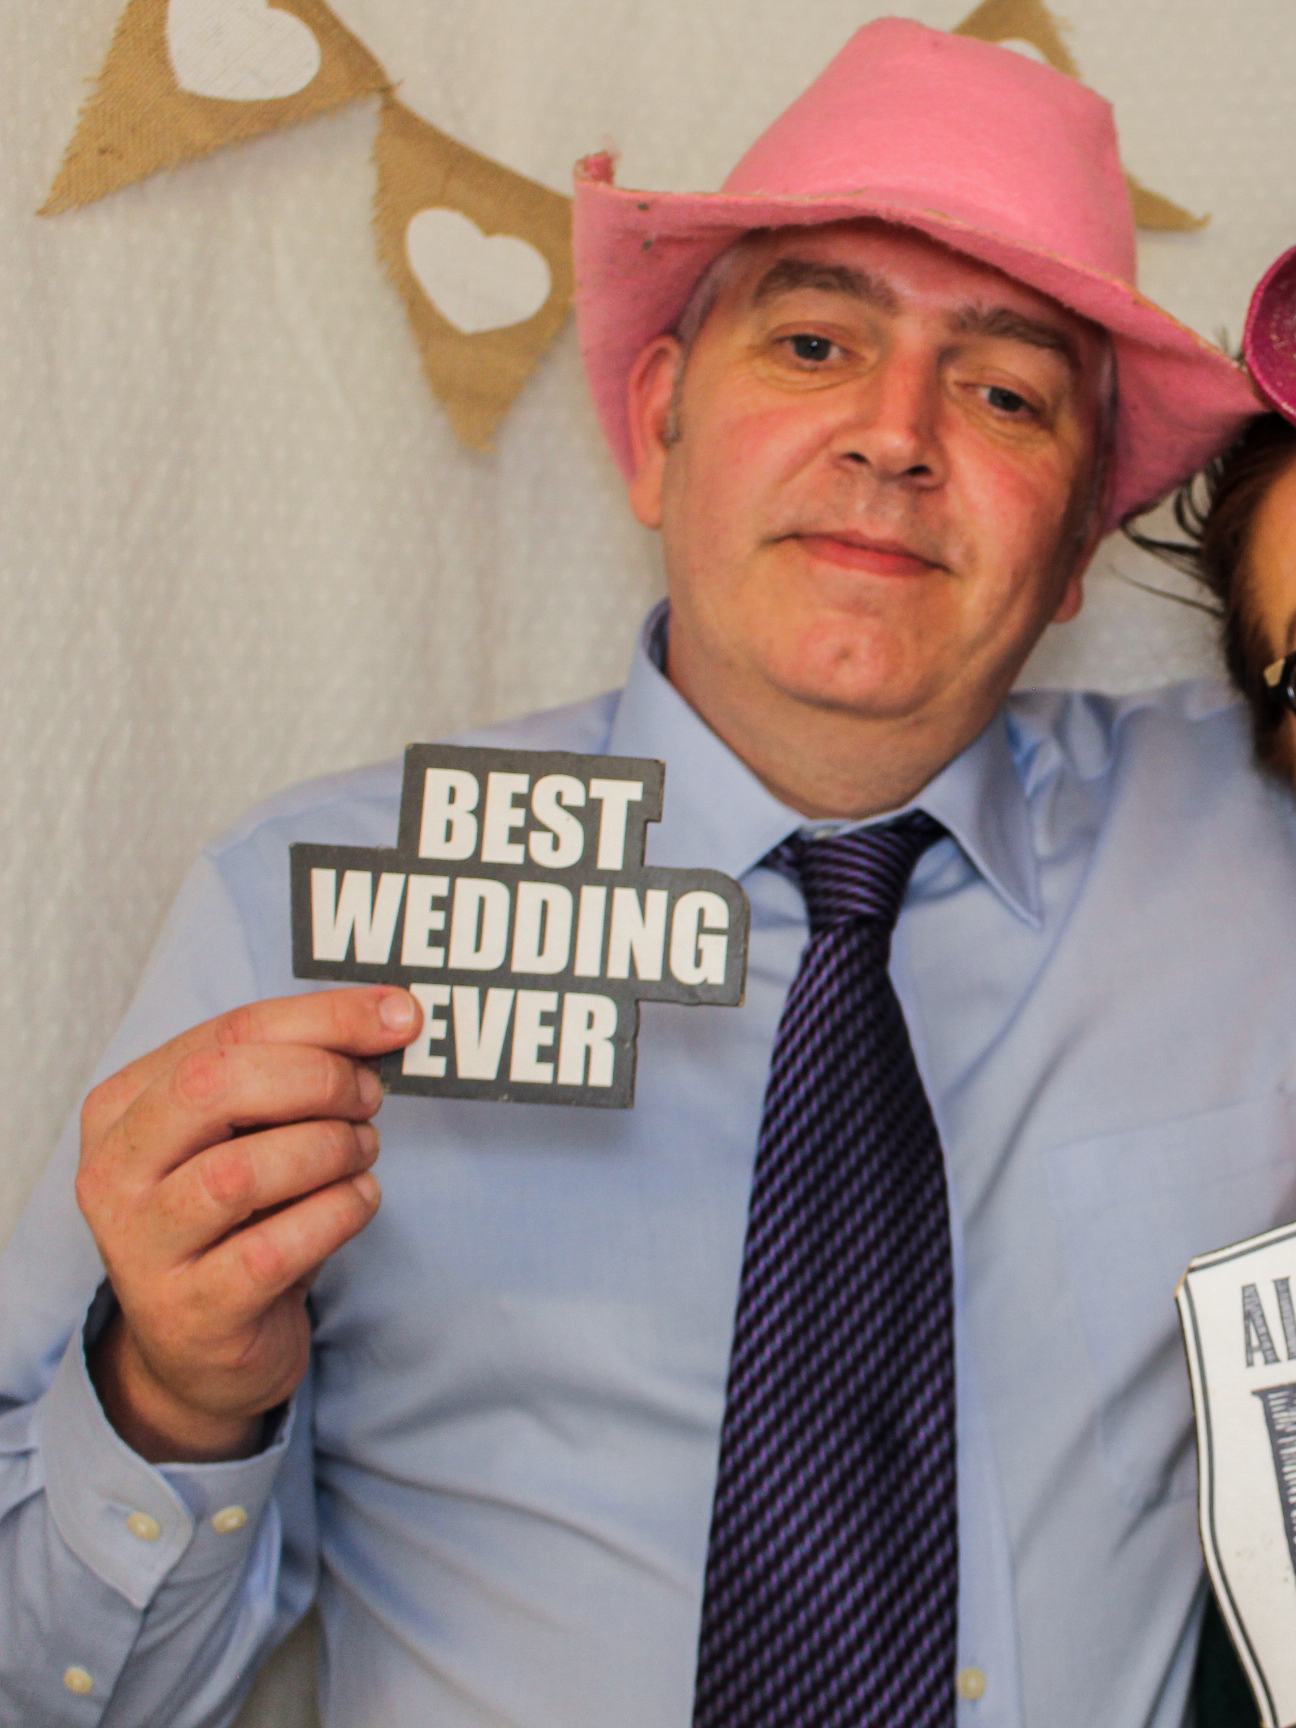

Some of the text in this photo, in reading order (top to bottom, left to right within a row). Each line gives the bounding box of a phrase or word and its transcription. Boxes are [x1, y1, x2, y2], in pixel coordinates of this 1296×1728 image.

[418, 767, 644, 871] BEST
[310, 867, 730, 986] WEDDING
[401, 982, 618, 1088] EVER
